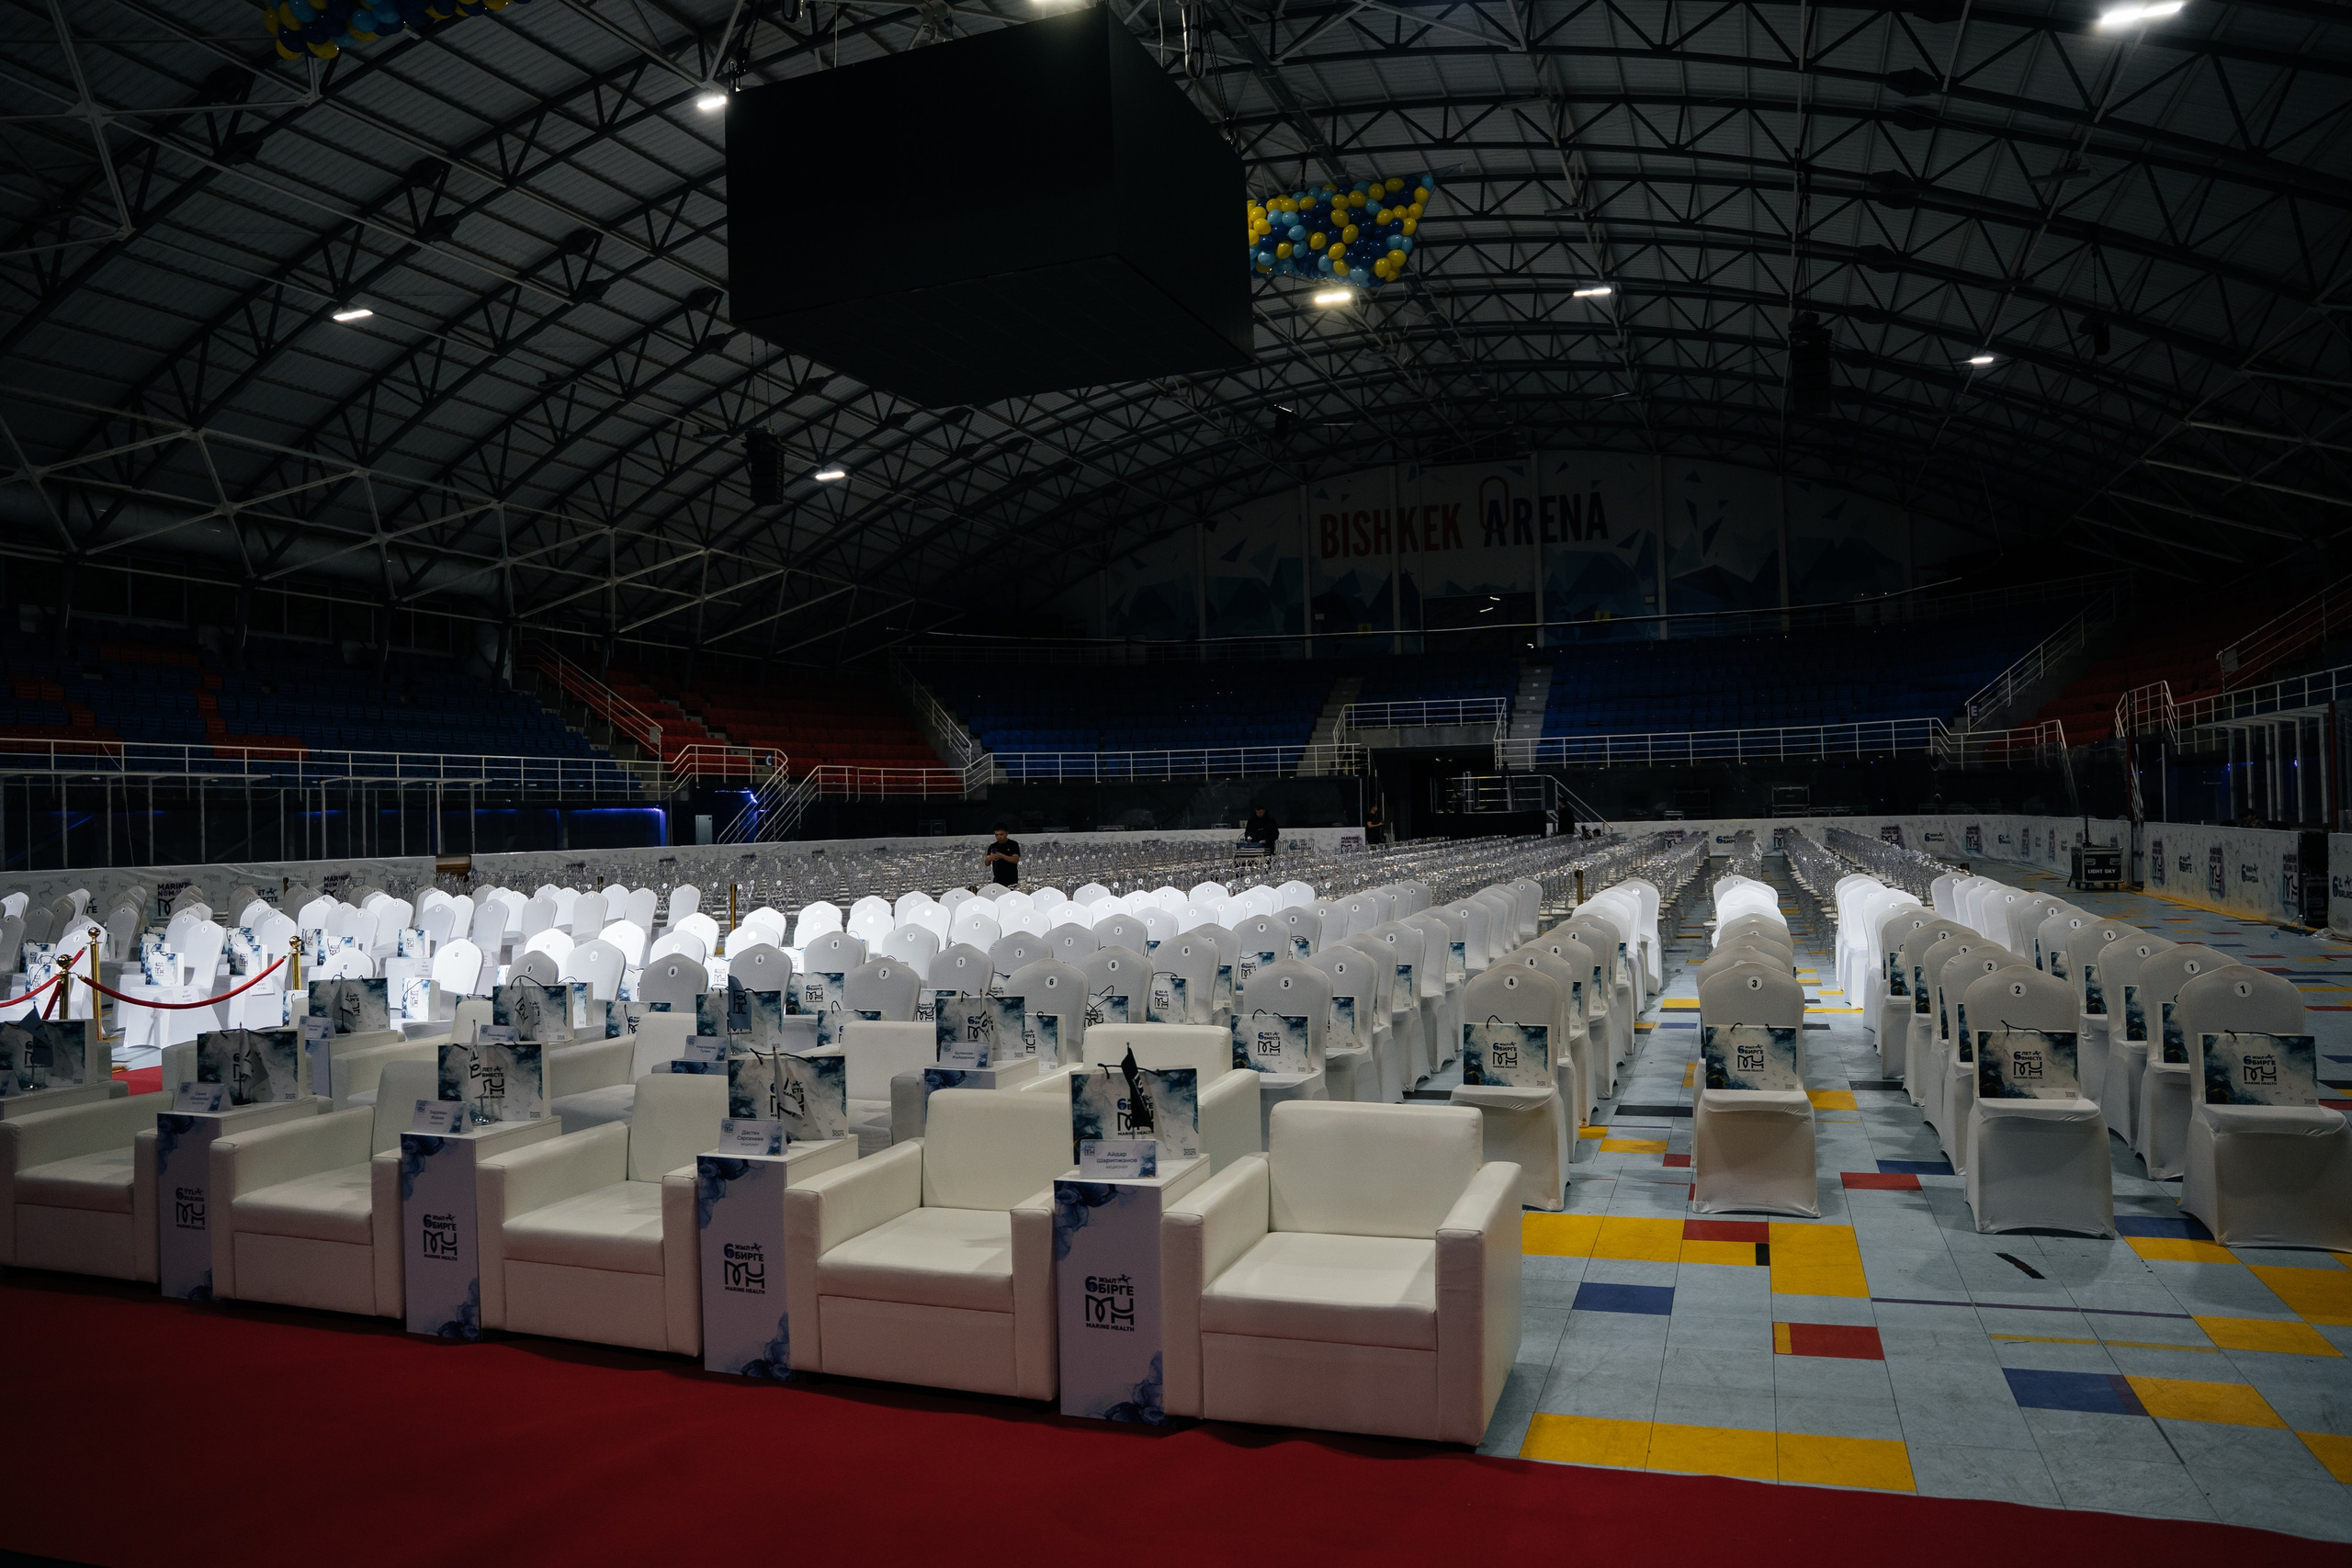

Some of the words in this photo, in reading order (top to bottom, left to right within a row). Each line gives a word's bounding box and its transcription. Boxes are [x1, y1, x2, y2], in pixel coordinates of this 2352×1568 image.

[1320, 502, 1464, 558] BISHKEK
[1484, 491, 1609, 547] ARENA
[1971, 705, 1978, 716] E
[1715, 835, 1723, 844] 6
[2333, 875, 2339, 897] 6
[1752, 979, 1758, 987] 3
[2015, 986, 2020, 994] 2
[2240, 985, 2245, 994] 1
[967, 1016, 975, 1025] 6
[1257, 1032, 1264, 1040] 6
[1492, 1043, 1499, 1052] 6
[1737, 1044, 1745, 1055] 6
[2013, 1051, 2021, 1061] 6
[2243, 1055, 2253, 1066] 6
[1116, 1098, 1127, 1111] 6
[175, 1187, 185, 1201] 6
[423, 1213, 433, 1228] 6
[432, 1221, 457, 1232] БИРГЕ
[723, 1243, 735, 1258] 6
[735, 1251, 764, 1262] БИРГЕ
[725, 1285, 745, 1293] MARINE
[1084, 1275, 1099, 1293] 6
[1098, 1276, 1117, 1284] ЖЫЛ
[1098, 1283, 1135, 1297] БІРГЕ
[1086, 1322, 1110, 1330] MARINE
[1111, 1324, 1135, 1332] HEALTH
